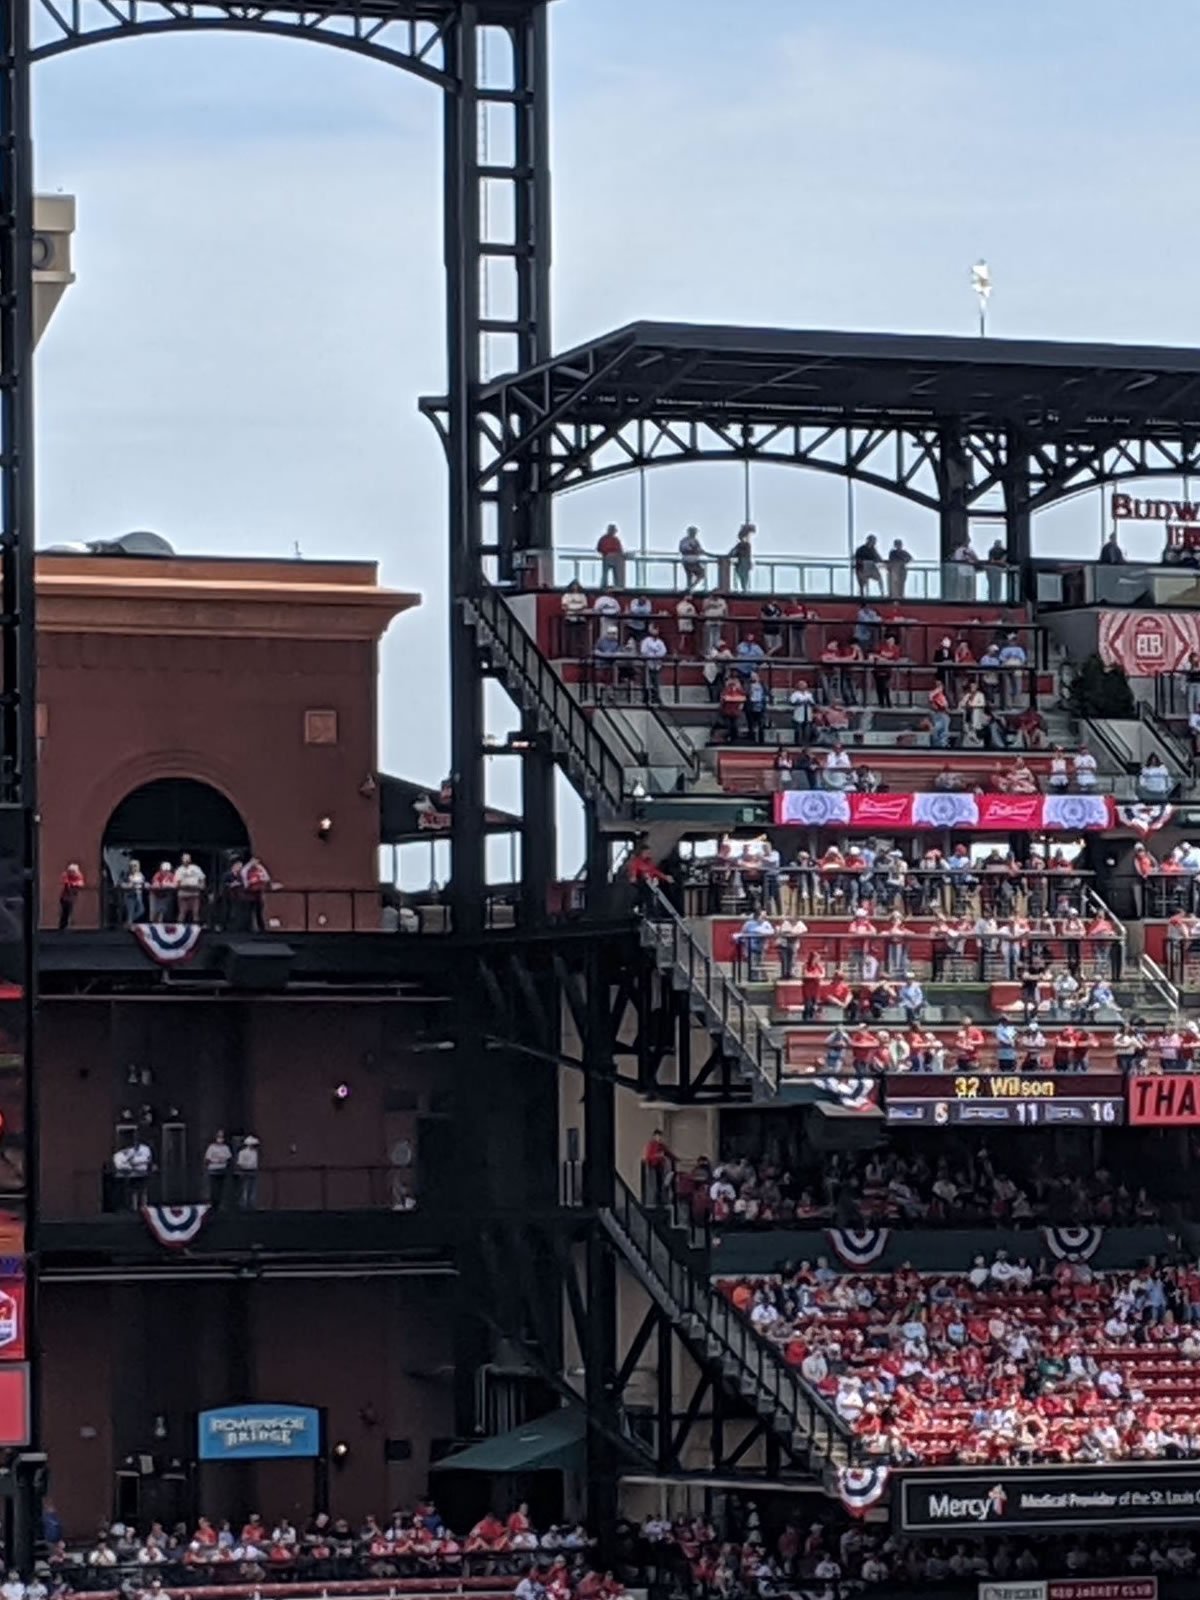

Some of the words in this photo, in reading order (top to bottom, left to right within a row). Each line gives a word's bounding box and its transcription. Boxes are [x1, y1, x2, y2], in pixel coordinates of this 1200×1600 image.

[954, 1077, 980, 1097] 32
[990, 1077, 1055, 1096] Wilson
[1016, 1102, 1038, 1123] 11
[227, 1430, 292, 1447] BRIDGE
[928, 1492, 990, 1520] Mercy
[1118, 1491, 1130, 1505] of
[1132, 1491, 1150, 1505] the
[1166, 1490, 1194, 1505] Louis
